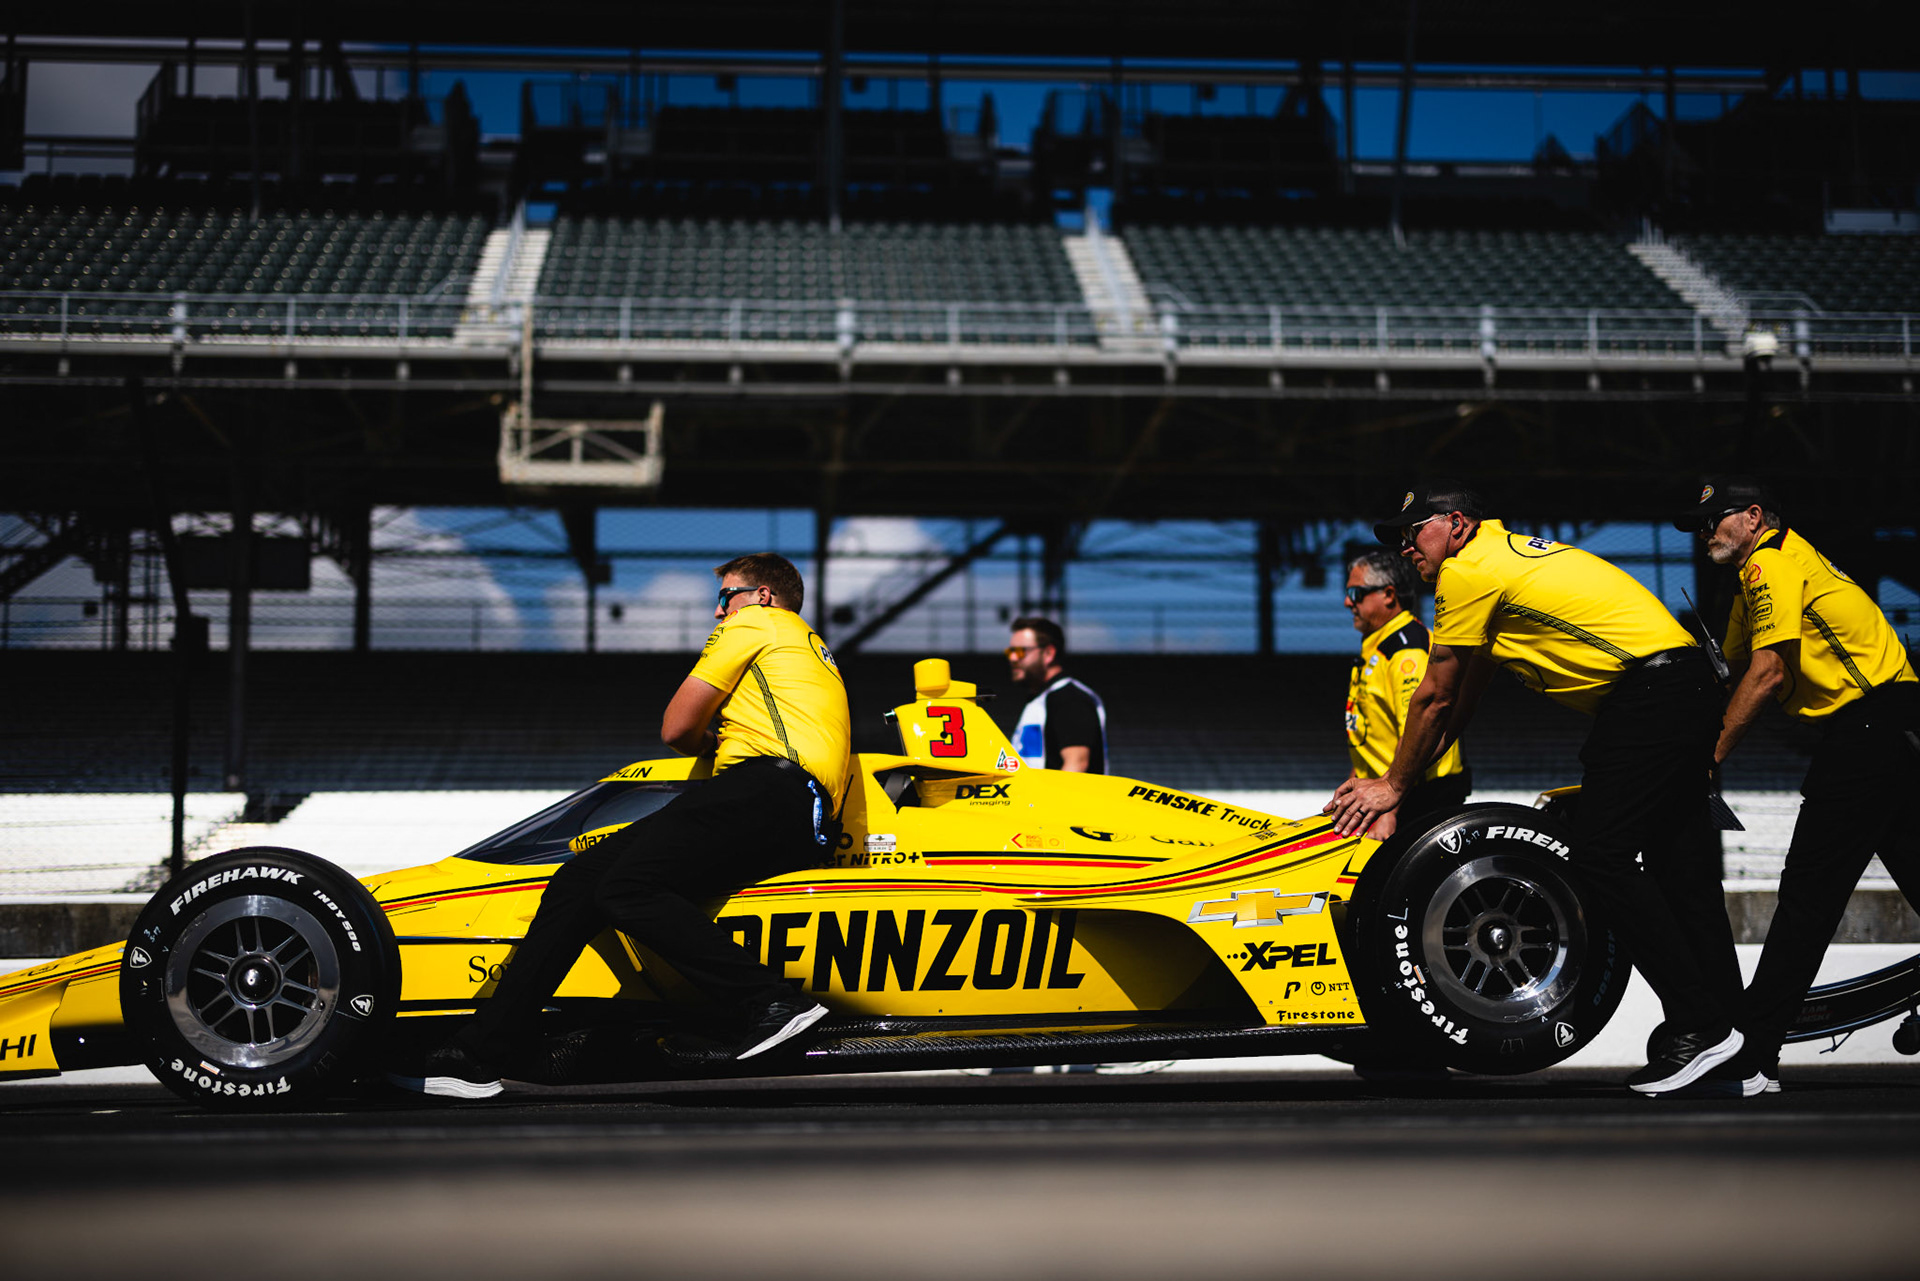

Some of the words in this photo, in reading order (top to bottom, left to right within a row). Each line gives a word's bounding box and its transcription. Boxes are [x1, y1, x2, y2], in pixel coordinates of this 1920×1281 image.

[926, 706, 968, 758] 3
[955, 784, 1012, 800] DEX
[969, 799, 1011, 807] imaging
[1127, 785, 1218, 816] PENSKE
[1218, 807, 1273, 832] Truck
[1485, 826, 1570, 861] FIREH
[170, 865, 305, 916] FIREHAWK
[468, 955, 508, 983] So
[1240, 941, 1337, 972] XPEL
[1328, 982, 1350, 992] NTT
[1394, 924, 1469, 1045] Firestone
[1276, 1010, 1356, 1022] Firestone
[0, 1033, 37, 1061] HI
[170, 1057, 292, 1098] Firestone
